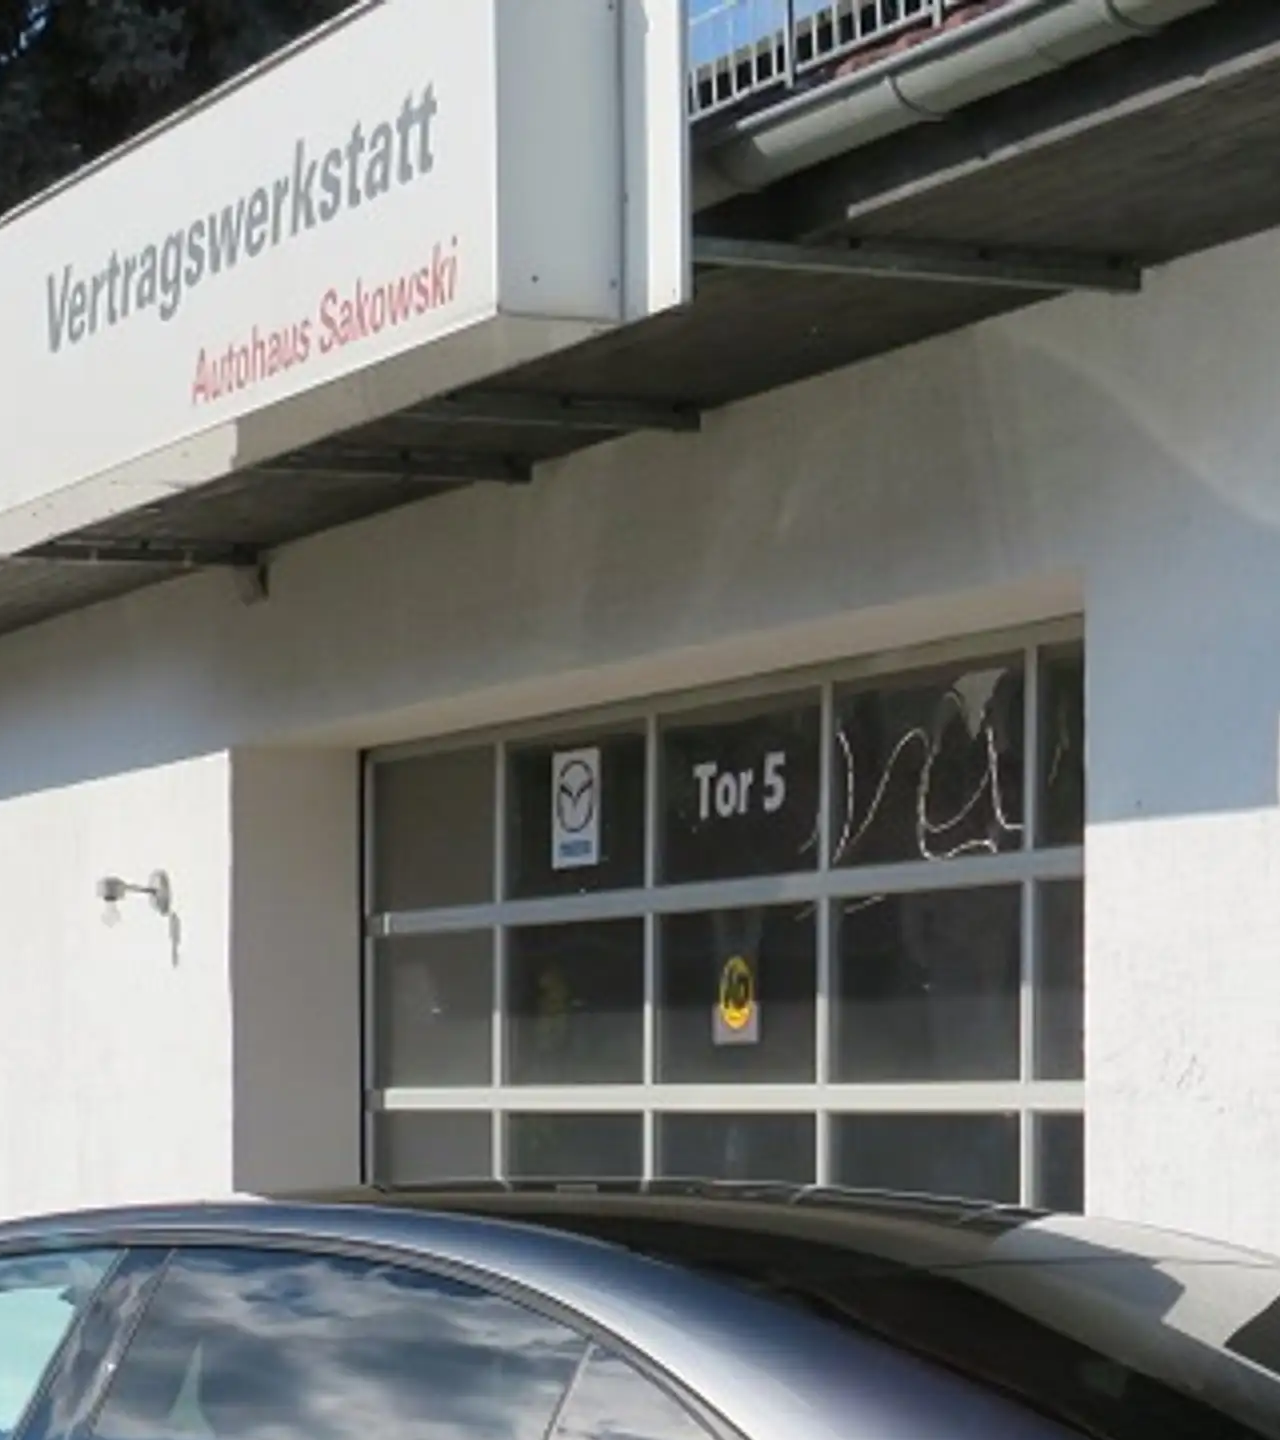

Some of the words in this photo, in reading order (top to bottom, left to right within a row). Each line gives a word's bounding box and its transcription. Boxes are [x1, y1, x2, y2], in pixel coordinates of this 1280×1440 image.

[47, 80, 438, 354] Vertragswerkstatt
[191, 315, 311, 405] Autohaus
[319, 234, 460, 354] Sakowski
[692, 760, 755, 821] Tor
[762, 750, 787, 813] 5
